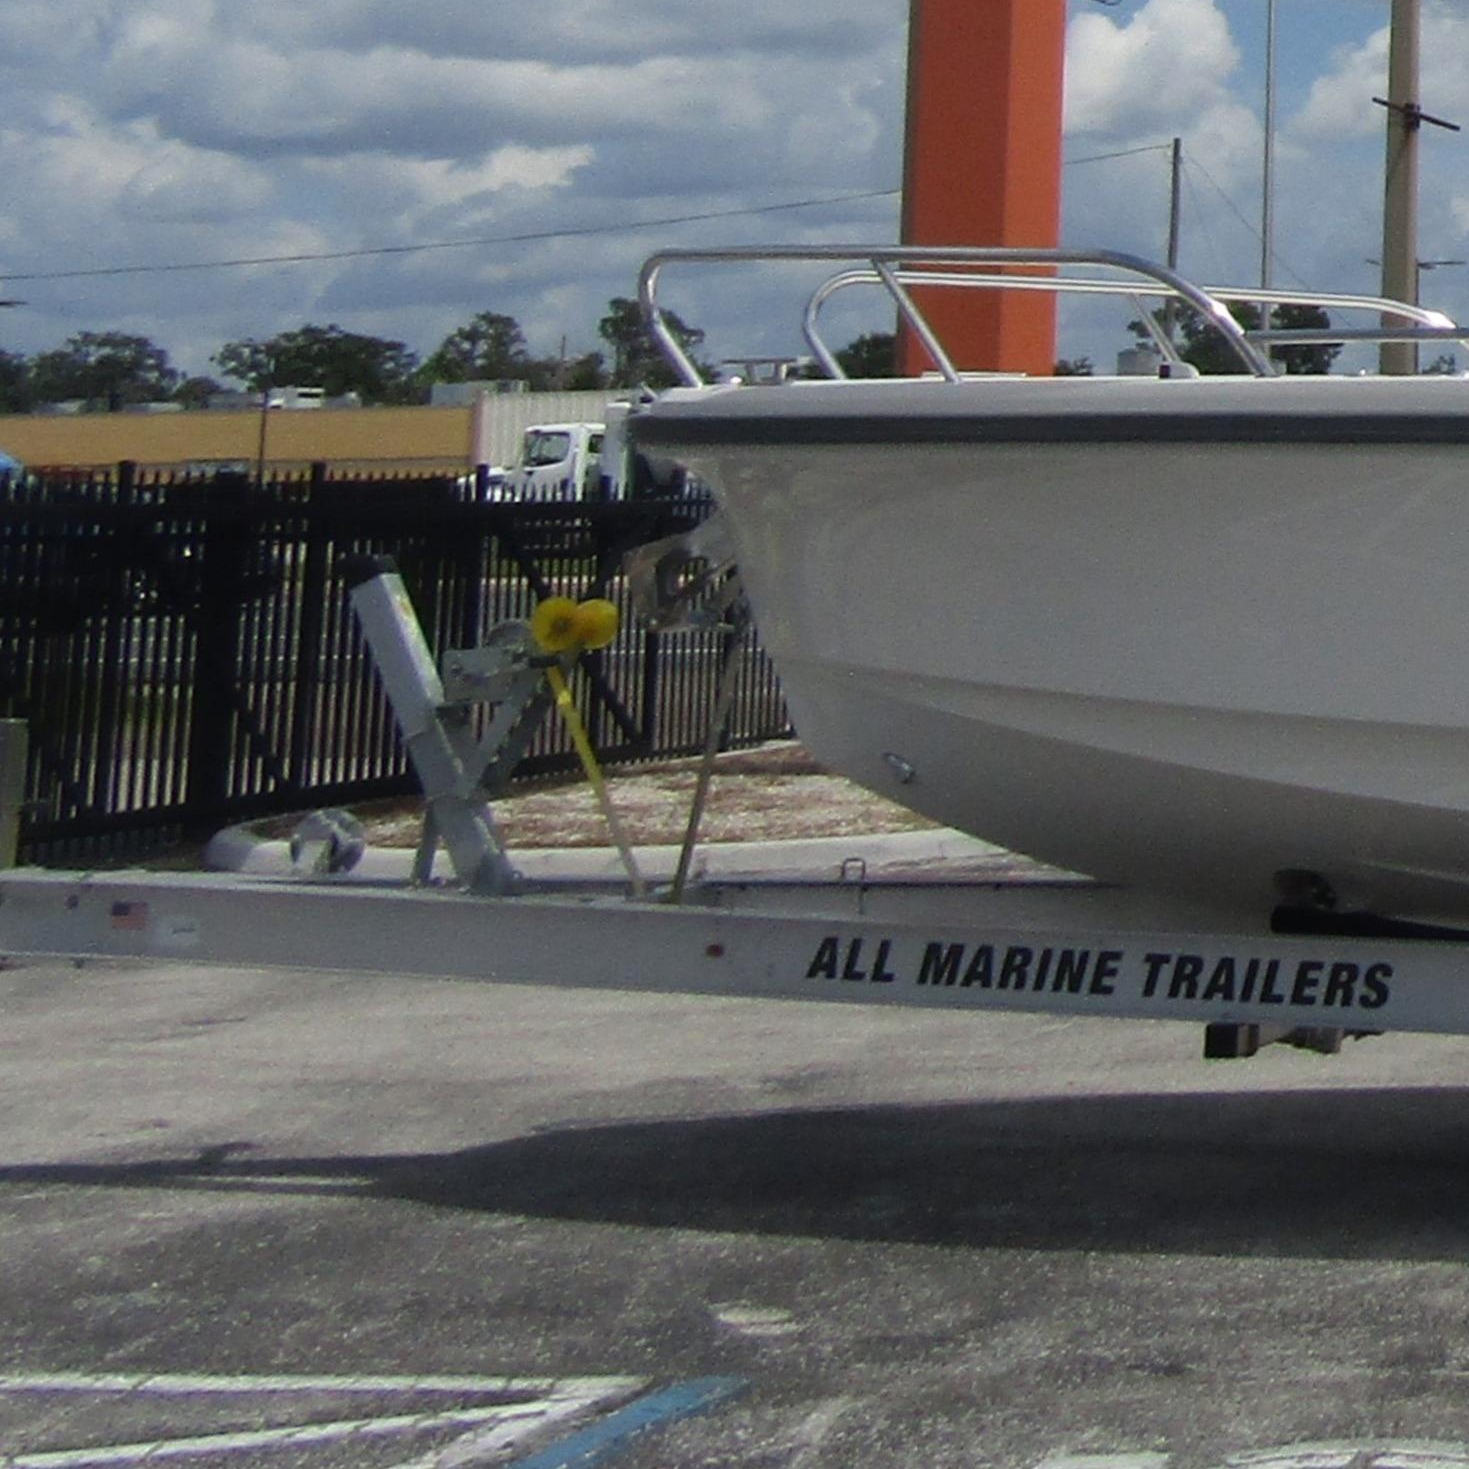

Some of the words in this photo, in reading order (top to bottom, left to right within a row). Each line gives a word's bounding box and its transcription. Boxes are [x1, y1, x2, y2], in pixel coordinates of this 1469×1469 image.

[806, 936, 895, 984] ALL
[916, 941, 1124, 997] MARINE
[1141, 953, 1394, 1010] TRAILERS
